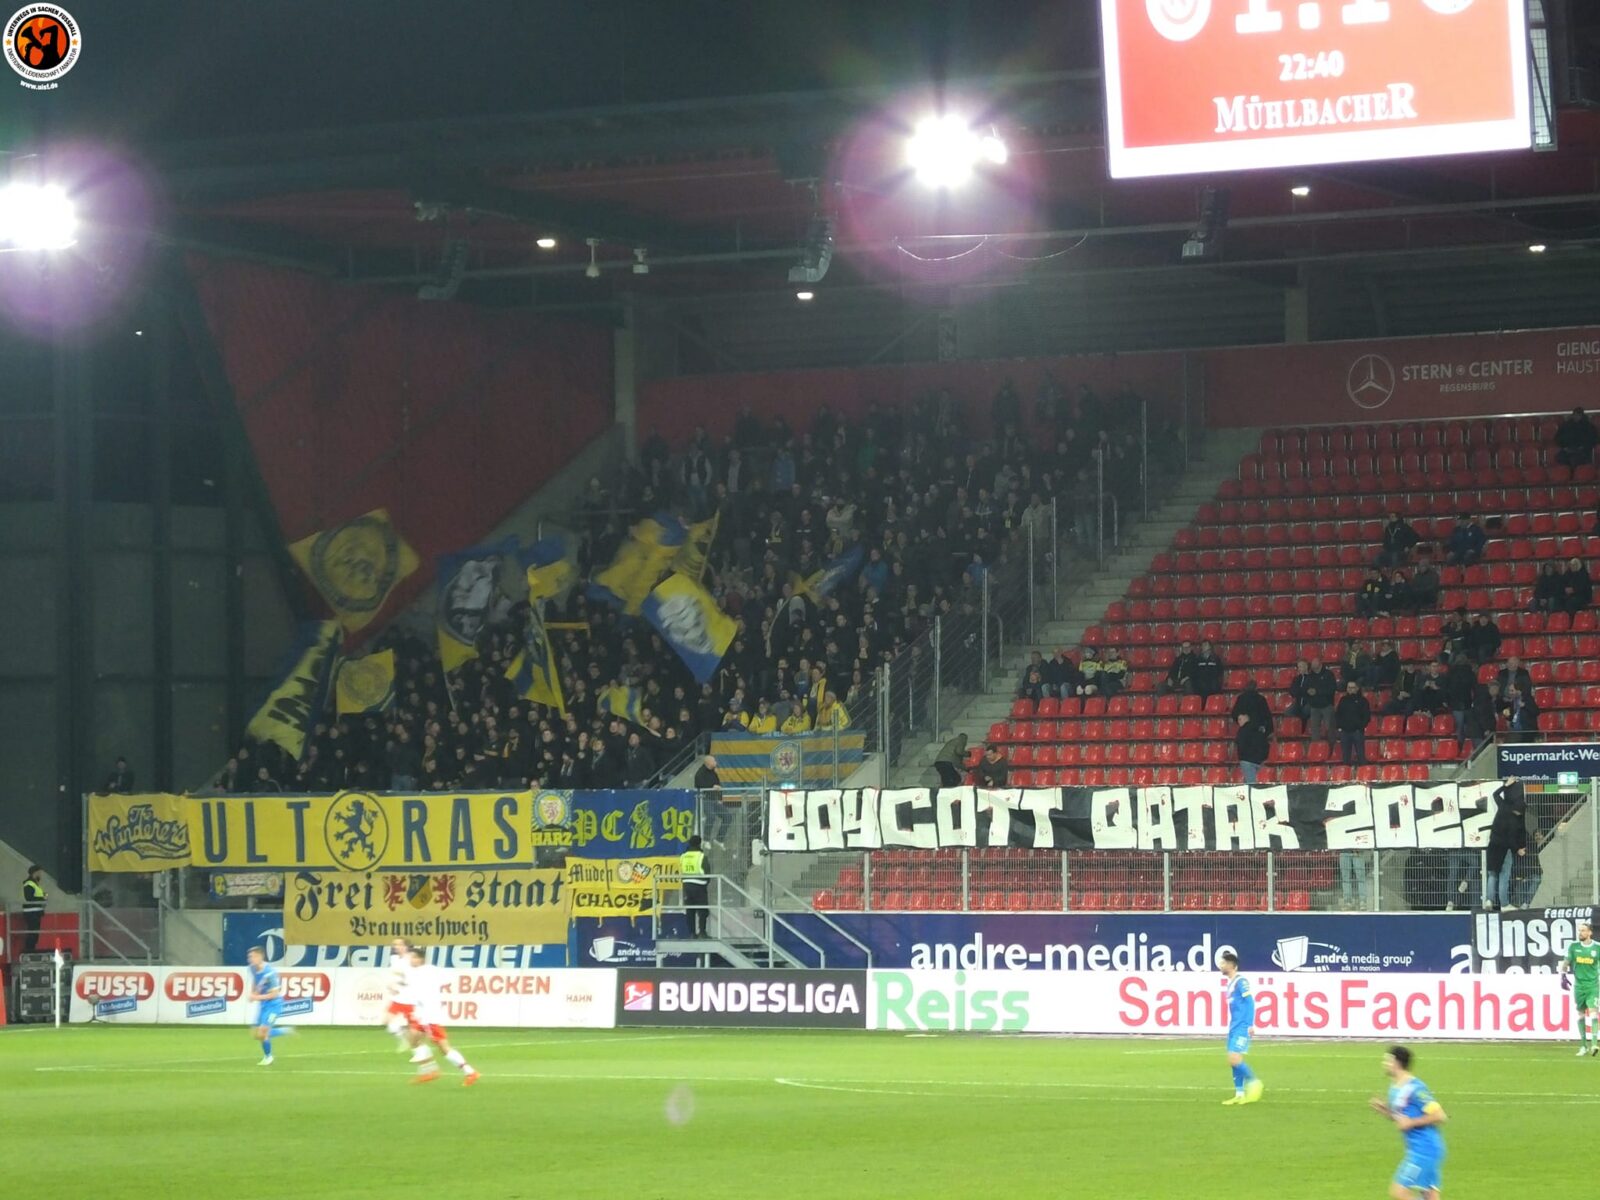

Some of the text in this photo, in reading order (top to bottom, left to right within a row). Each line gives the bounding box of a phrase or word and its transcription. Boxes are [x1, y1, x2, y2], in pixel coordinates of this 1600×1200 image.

[1278, 50, 1344, 80] 22:40
[1213, 82, 1417, 134] MÜHLBACHER
[1402, 359, 1533, 381] STERN CENTER
[1439, 382, 1496, 393] REGENSBURG
[768, 780, 1505, 850] BOYCOTT QATAR 2022
[94, 815, 190, 858] Wanderers
[531, 831, 573, 846] HARZ
[570, 808, 625, 847] PC
[294, 871, 374, 922] Frei
[575, 891, 640, 909] CHAOS
[350, 916, 489, 941] Braunschweig
[1313, 950, 1412, 967] andré media group
[83, 976, 149, 996] FUSSL
[172, 976, 238, 997] FUSSL
[279, 976, 325, 997] USSL
[458, 975, 551, 995] BACKEN
[357, 993, 383, 1001] HAHN
[566, 994, 592, 1003] HAHN
[658, 981, 859, 1014] BUNDESLIGA
[872, 972, 1030, 1031] Reiss
[1118, 976, 1330, 1030] Sanitäts
